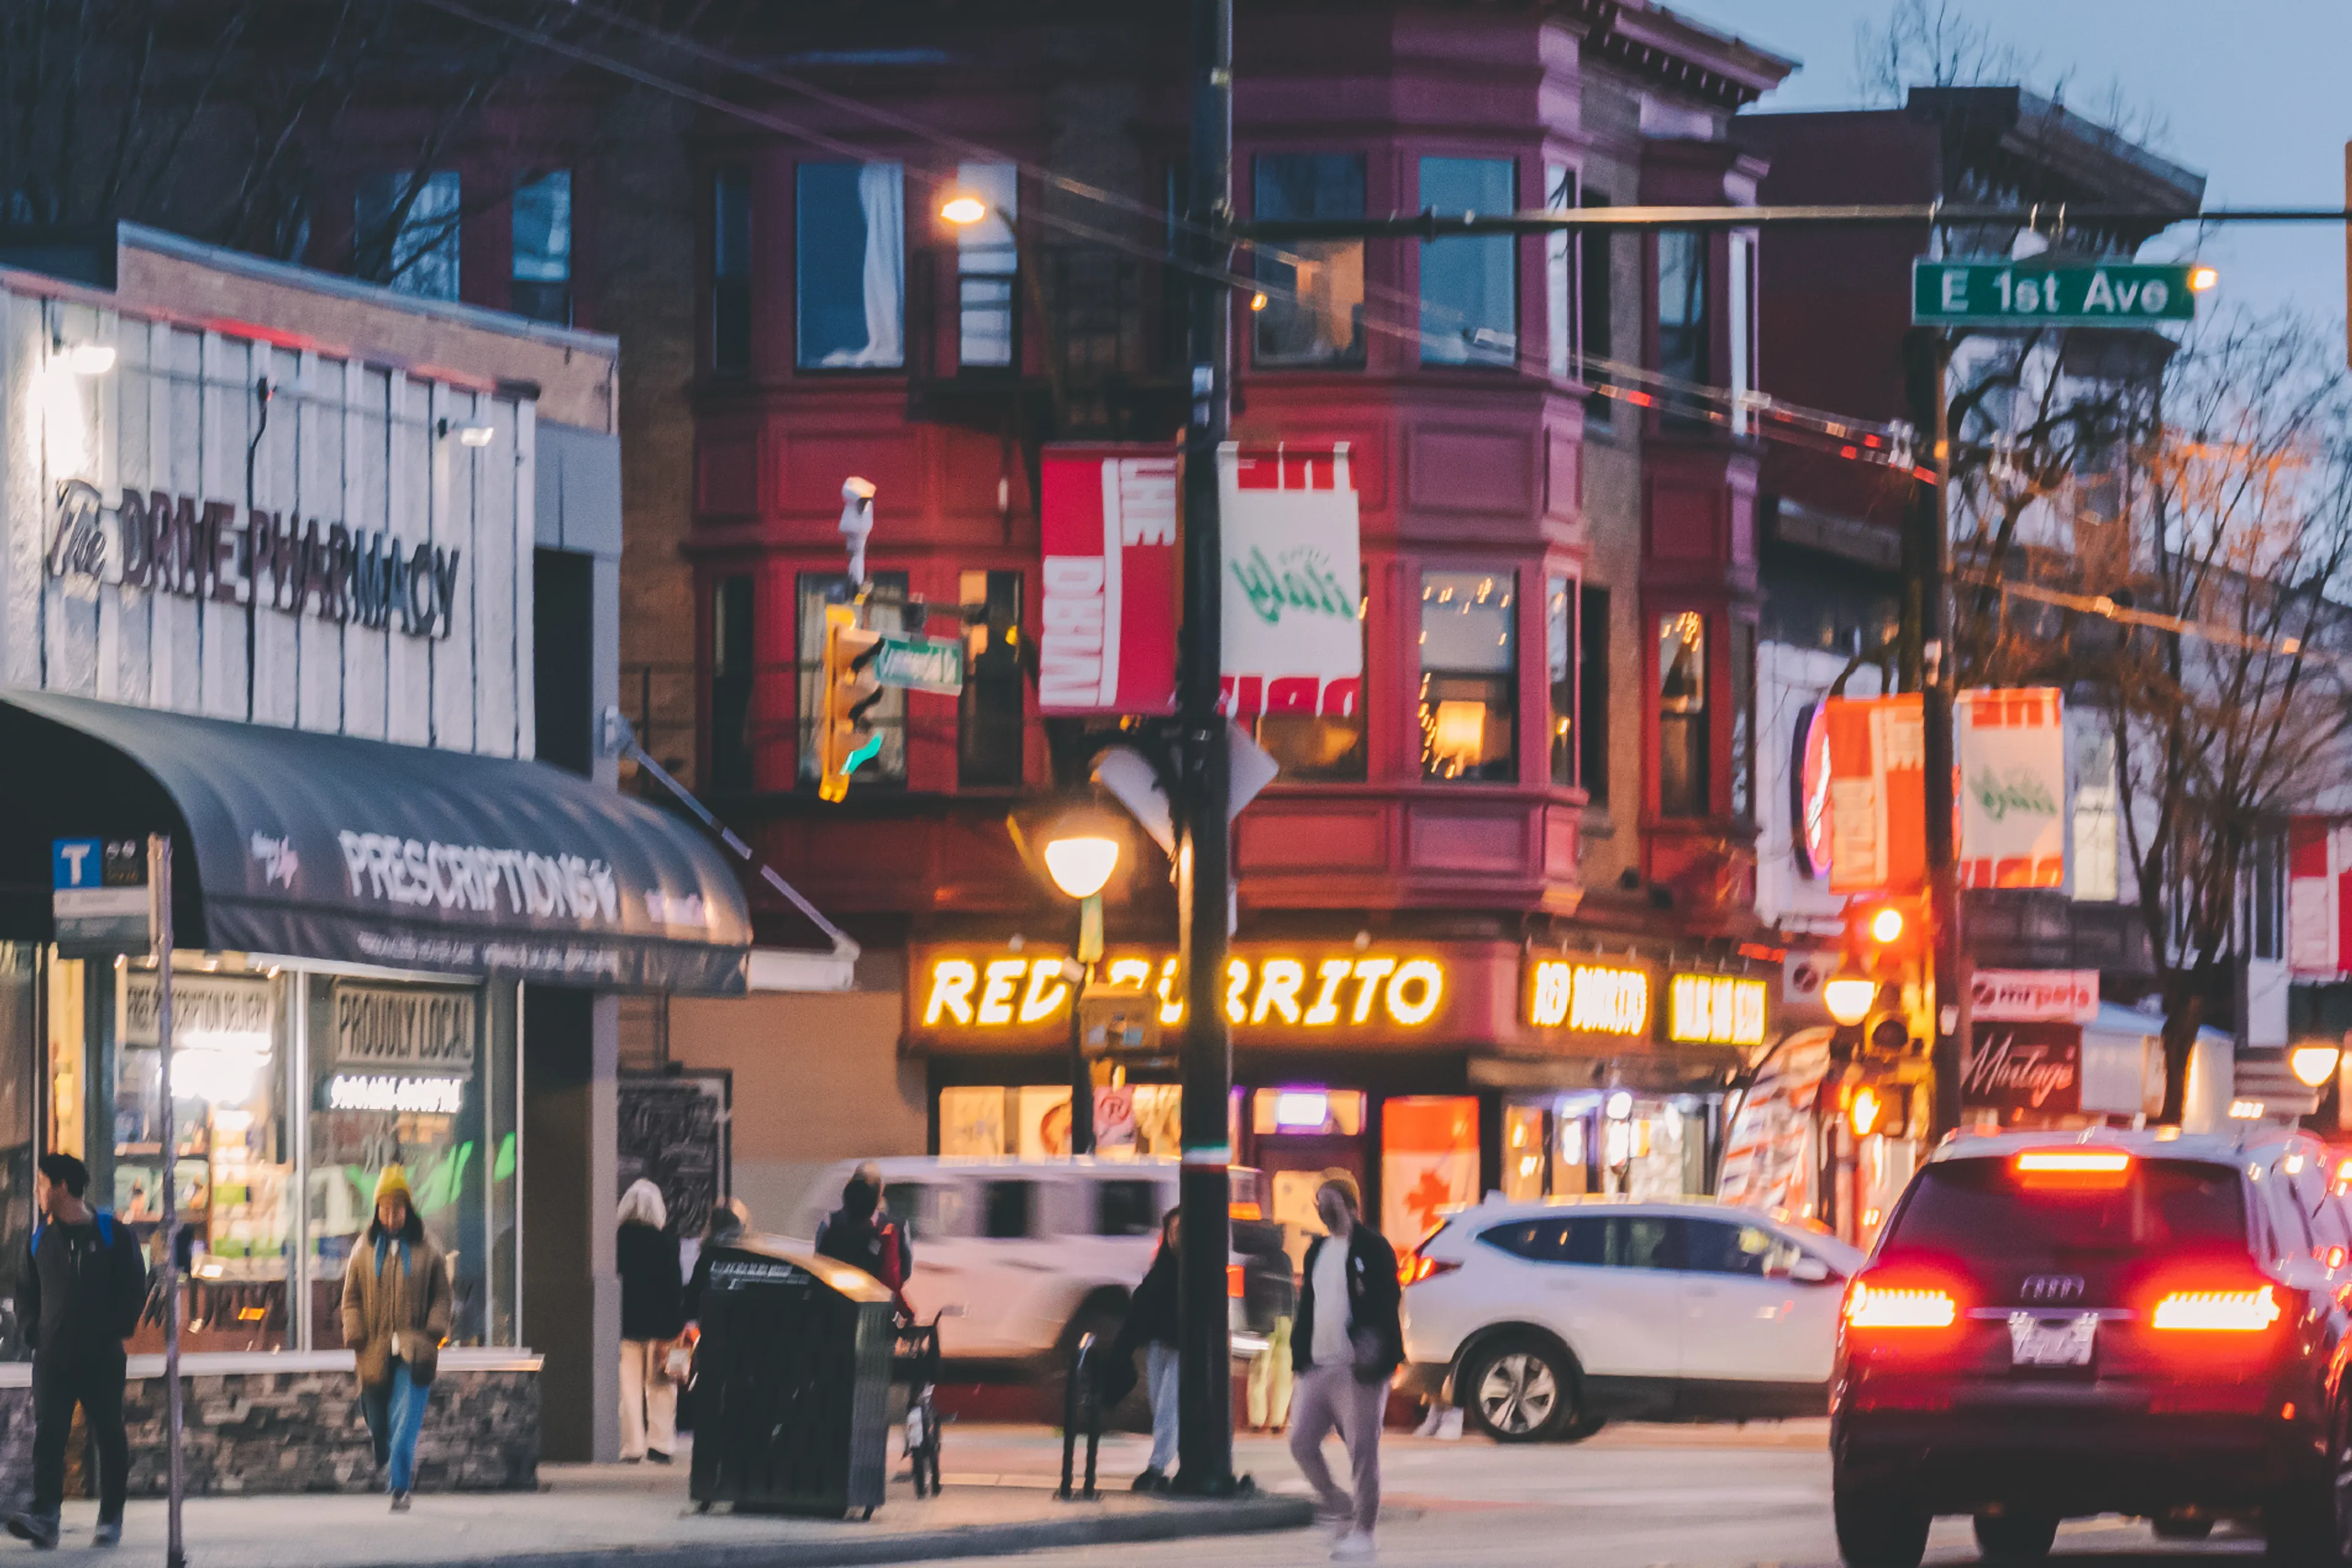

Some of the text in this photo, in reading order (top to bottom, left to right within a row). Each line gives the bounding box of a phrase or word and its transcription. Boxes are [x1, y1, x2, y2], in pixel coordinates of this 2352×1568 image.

[1942, 267, 2168, 312] E 1st Ave
[121, 488, 236, 601] DRIVE
[248, 510, 461, 639] PHARMACY
[340, 993, 473, 1060] PROUDLY LOCAL
[924, 958, 1068, 1027] RED
